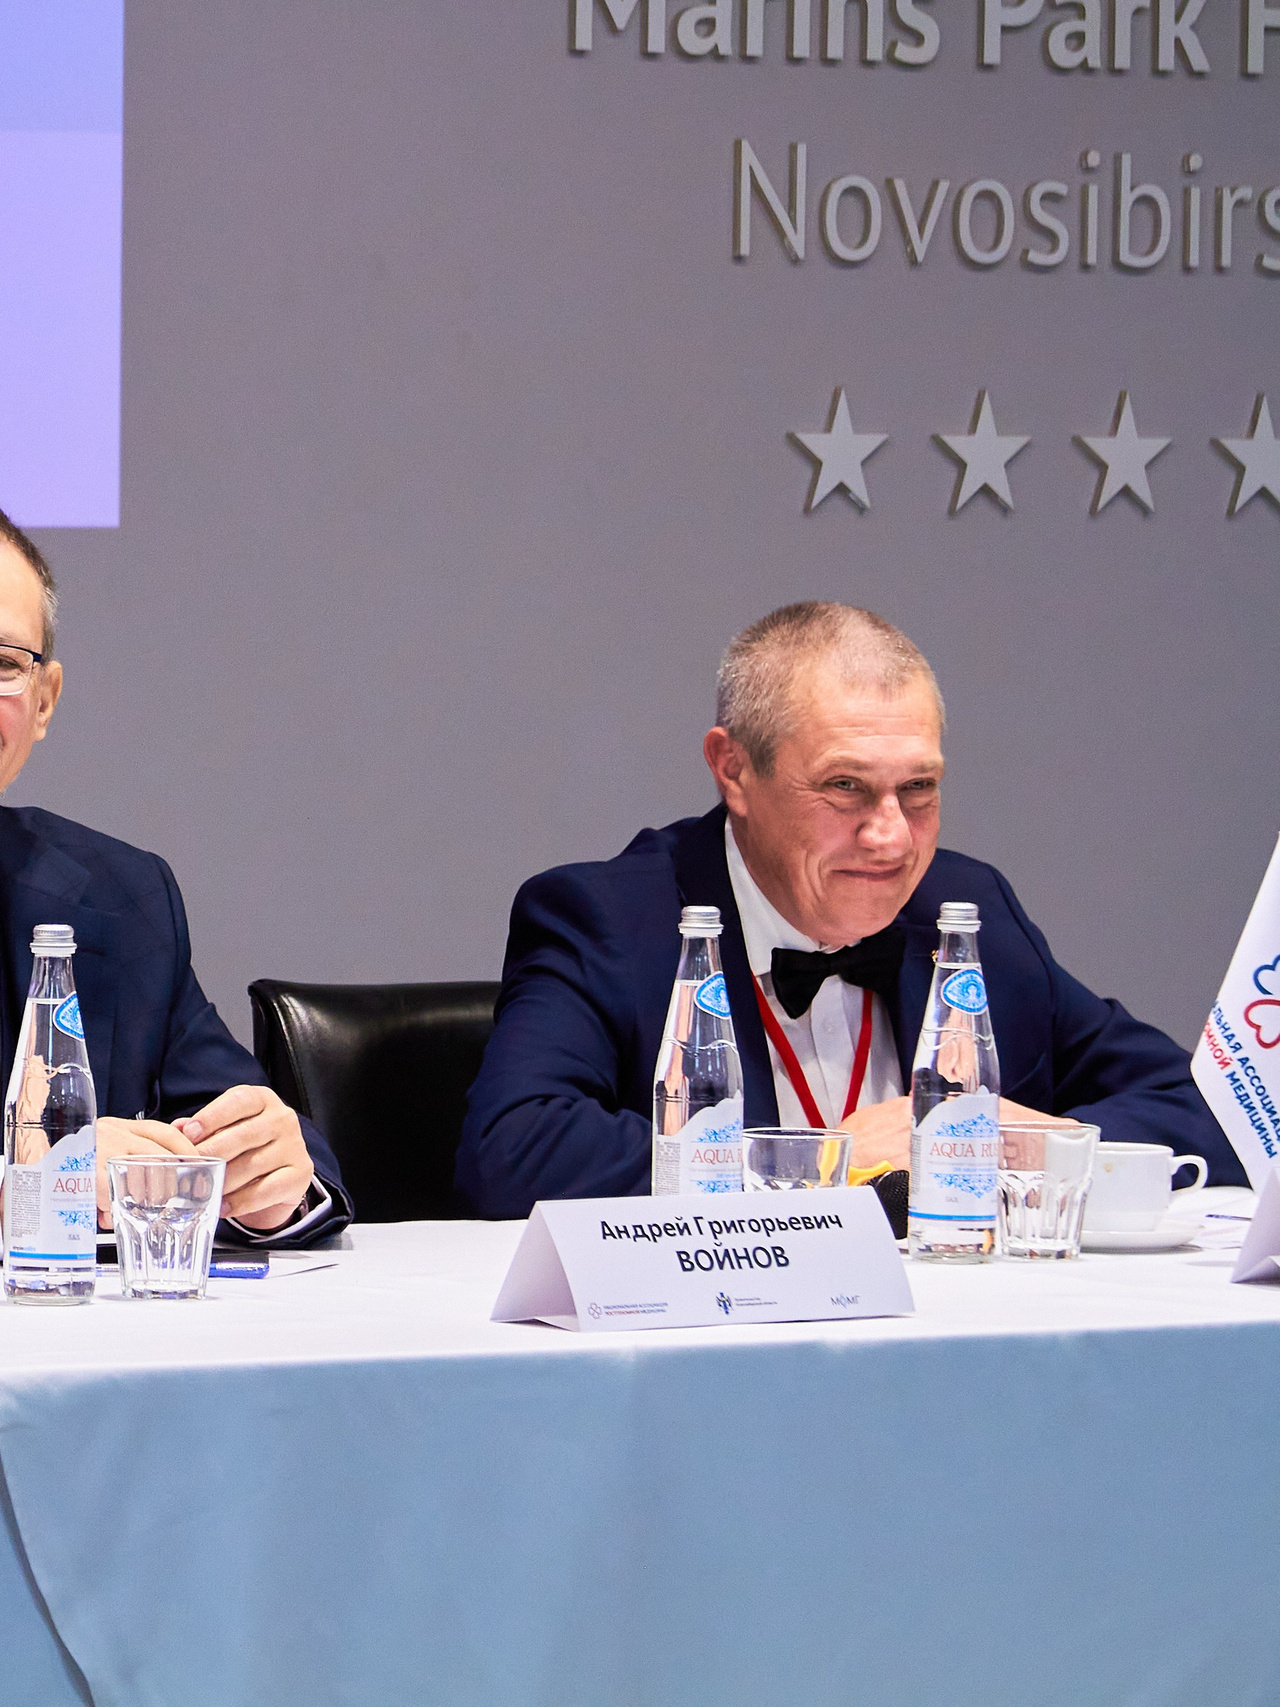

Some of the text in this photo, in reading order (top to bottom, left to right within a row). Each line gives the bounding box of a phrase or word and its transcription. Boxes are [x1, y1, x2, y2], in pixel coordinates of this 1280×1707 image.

[980, 0, 1211, 73] Park
[1225, 1071, 1277, 1158] МЕДИЦИНЫ
[691, 1149, 735, 1165] AQUA
[930, 1142, 976, 1158] AQUA
[53, 1178, 93, 1194] AQUA
[600, 1214, 843, 1243] Андрей Григорьевич
[676, 1242, 790, 1272] ВОЙНОВ
